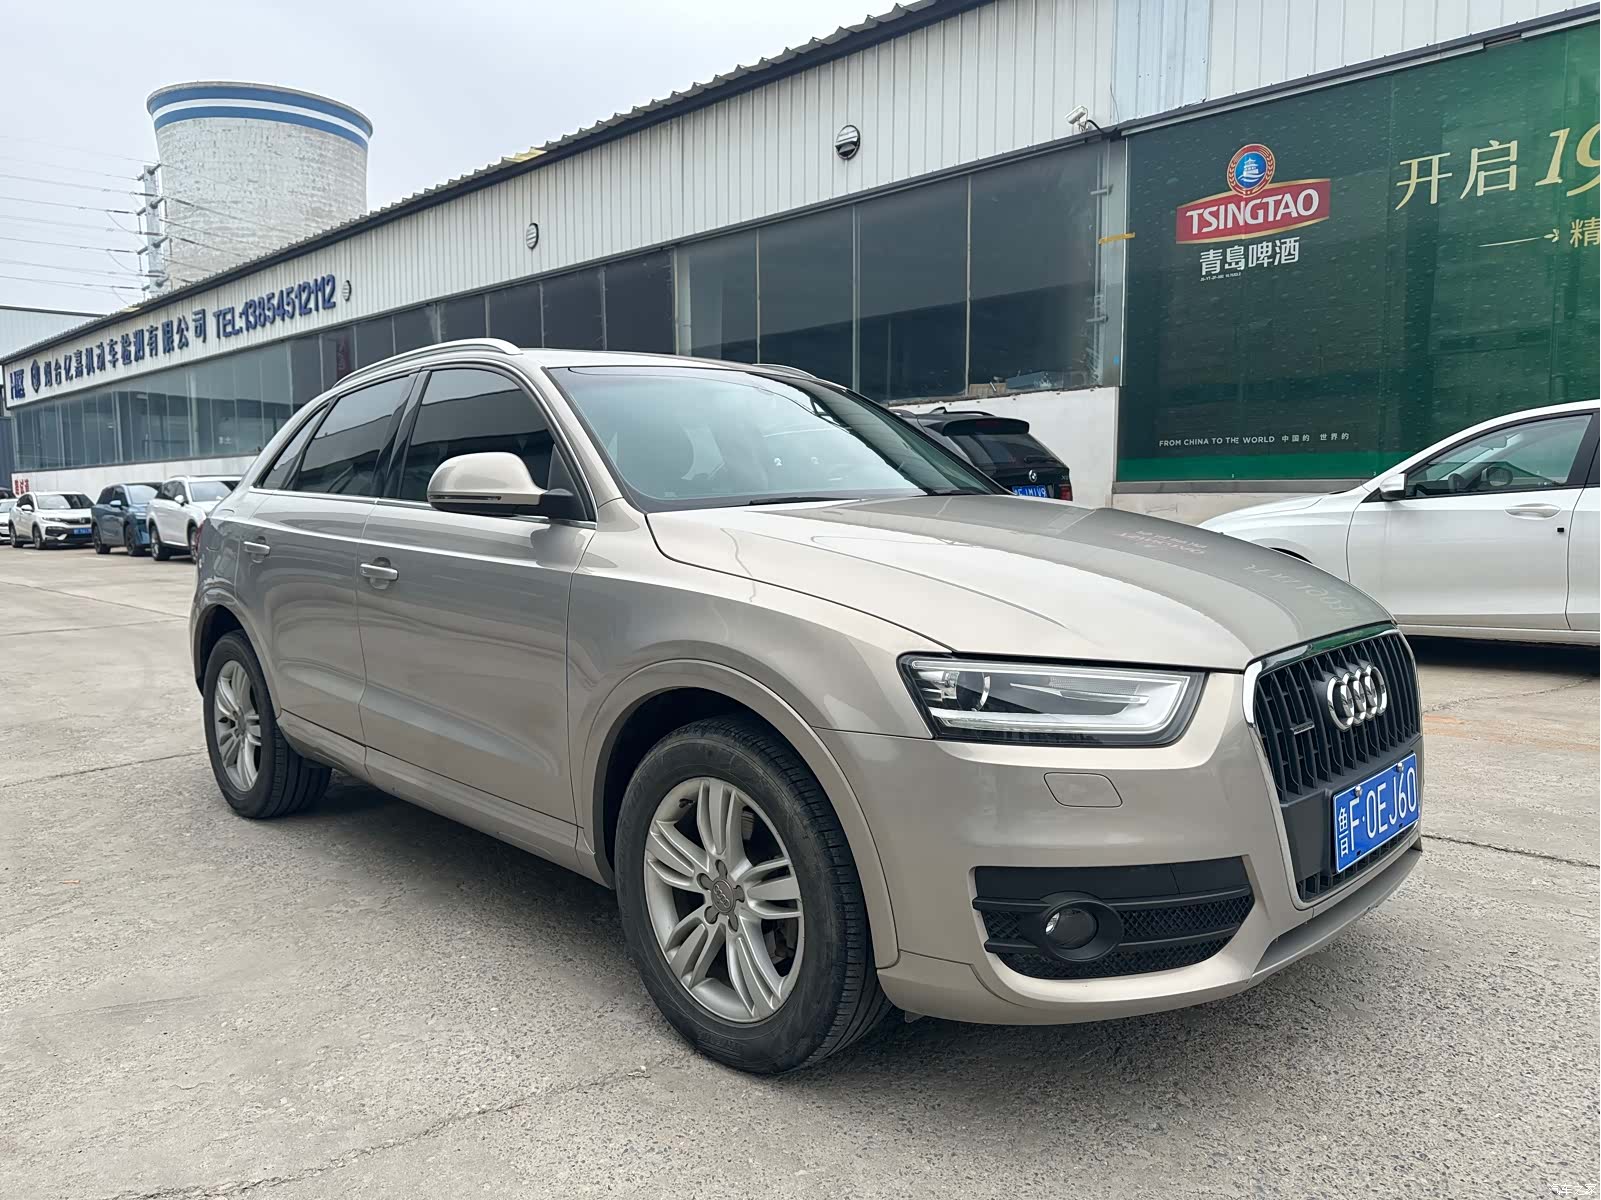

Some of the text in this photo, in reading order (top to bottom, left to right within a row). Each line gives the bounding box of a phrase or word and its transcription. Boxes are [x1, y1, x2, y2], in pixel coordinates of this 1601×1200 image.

[1395, 140, 1518, 210] 开启
[1186, 189, 1319, 234] TSINGTAO
[1569, 217, 1600, 247] 精
[1200, 237, 1300, 275] 青岛啤酒
[1184, 438, 1209, 446] CHINA
[1243, 435, 1275, 443] WORLD
[1282, 434, 1310, 442] 中国的
[1320, 433, 1350, 441] 世界的
